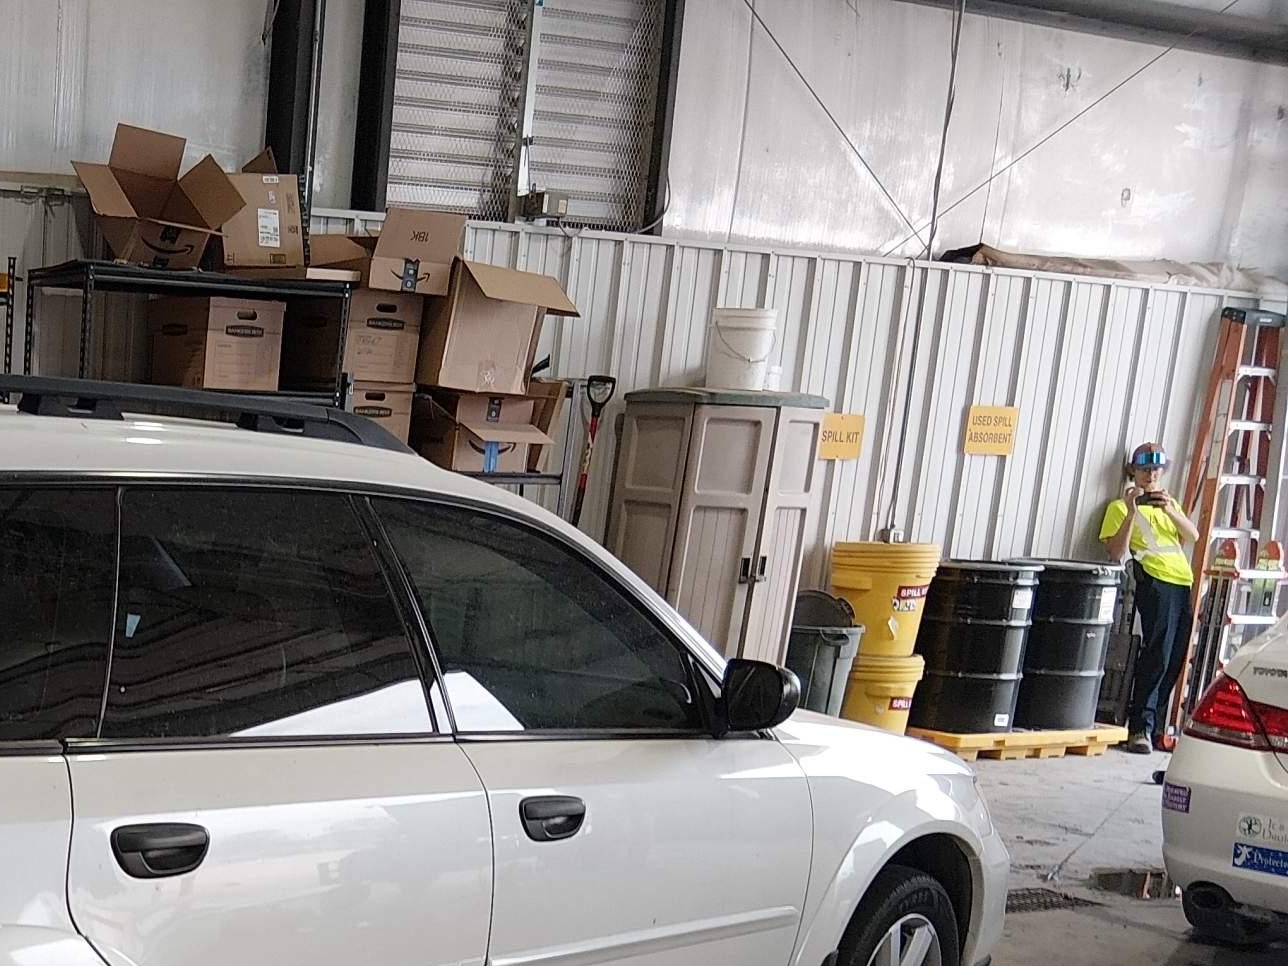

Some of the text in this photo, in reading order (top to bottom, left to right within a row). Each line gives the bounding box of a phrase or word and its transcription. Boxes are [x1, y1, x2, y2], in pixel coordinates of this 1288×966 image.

[972, 415, 1012, 428] USED SPILL
[821, 430, 860, 444] SPILL KIT
[968, 431, 1012, 444] ABSORBENT
[900, 587, 921, 597] SPILL
